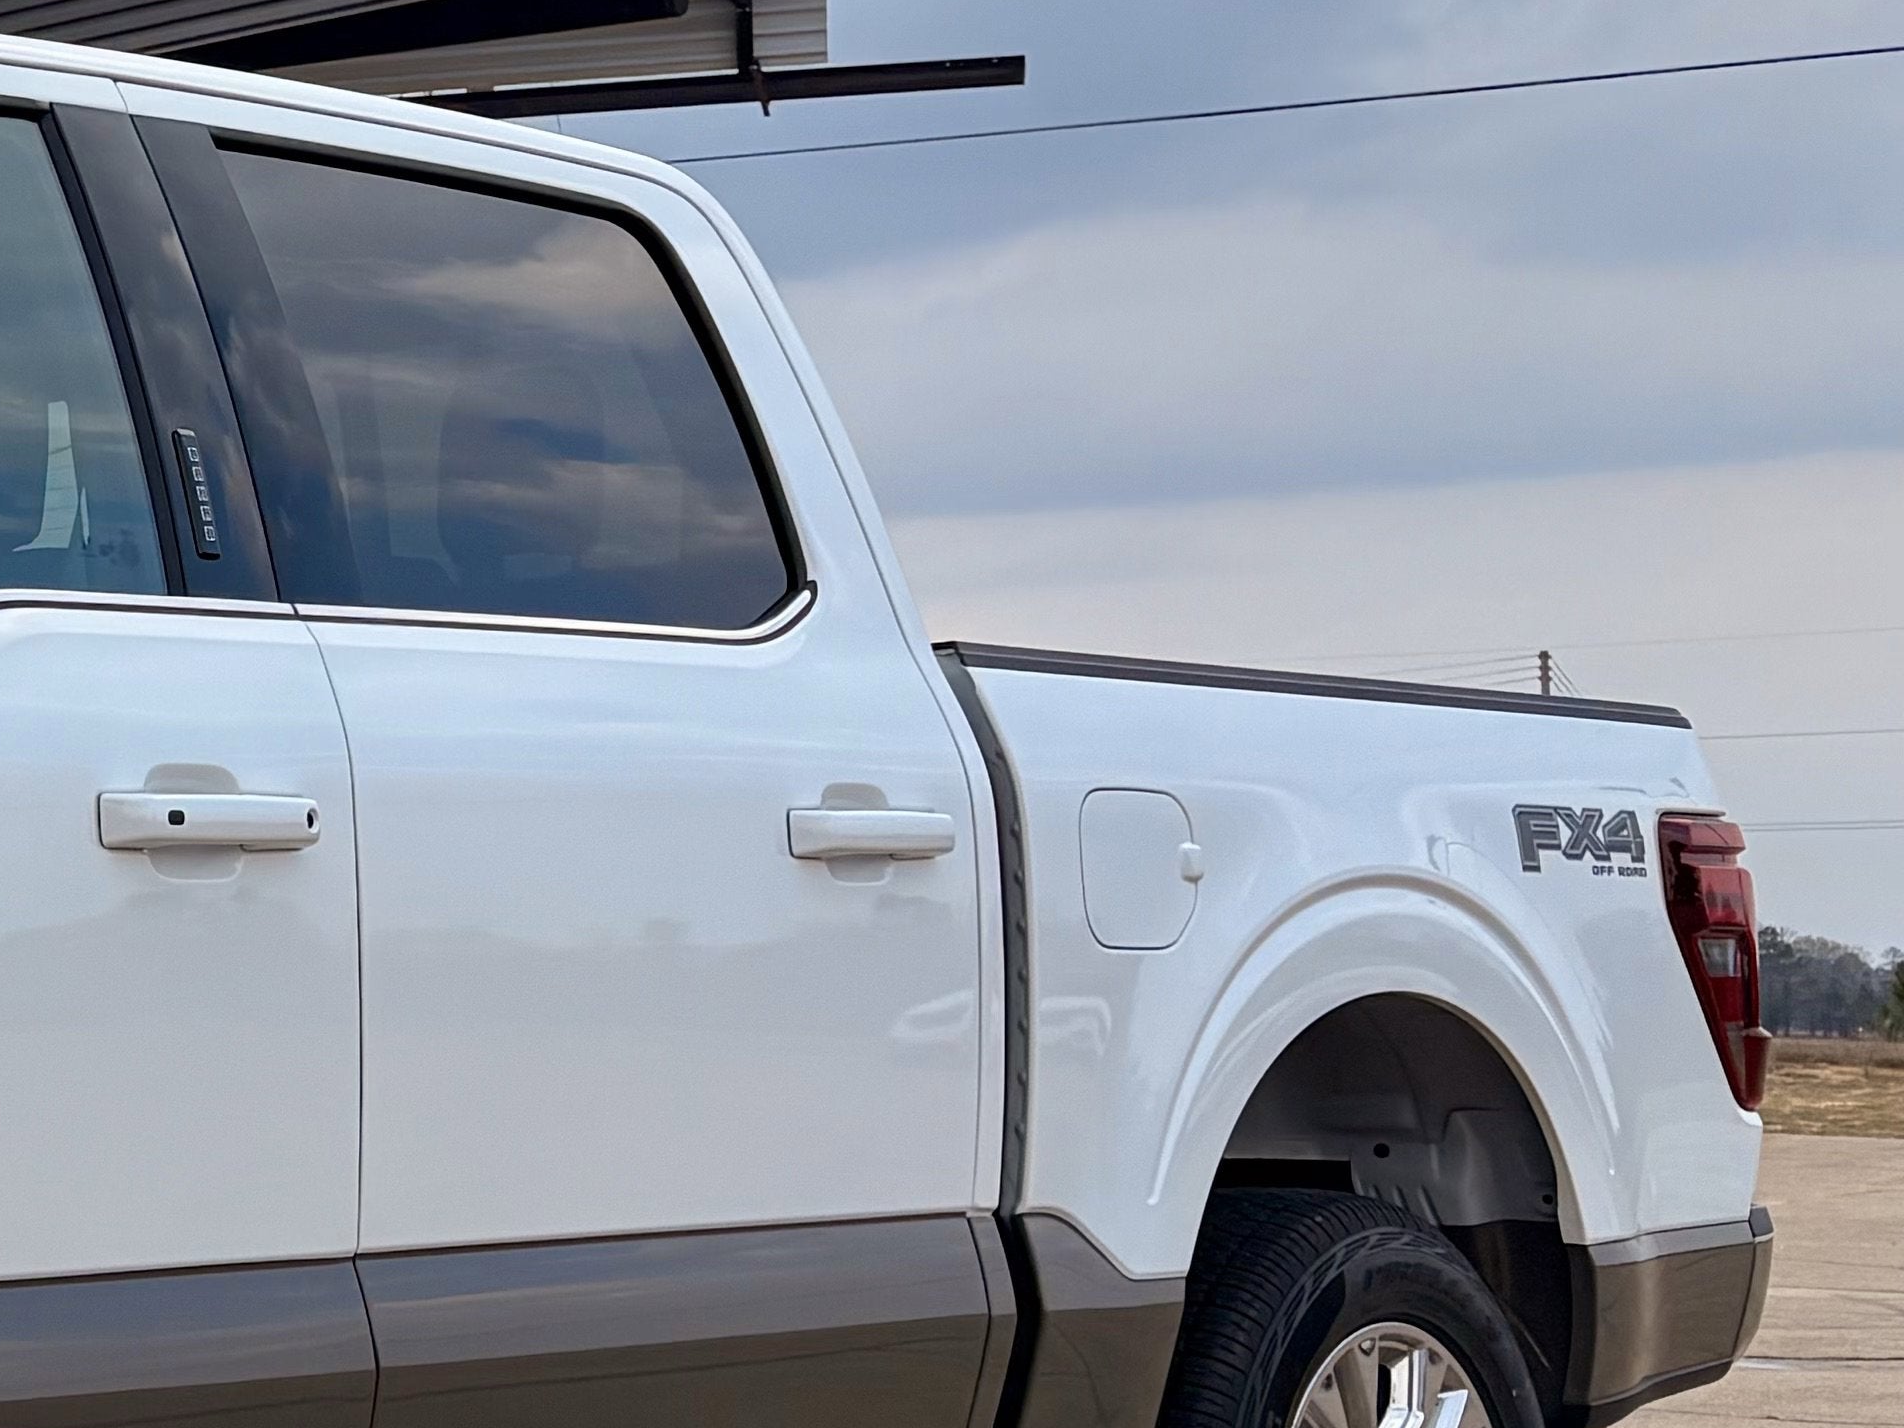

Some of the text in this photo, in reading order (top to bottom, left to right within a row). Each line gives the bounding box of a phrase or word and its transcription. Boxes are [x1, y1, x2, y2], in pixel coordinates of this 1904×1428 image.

[1512, 804, 1645, 873] FX4
[1592, 865, 1647, 877] OFF ROAD
